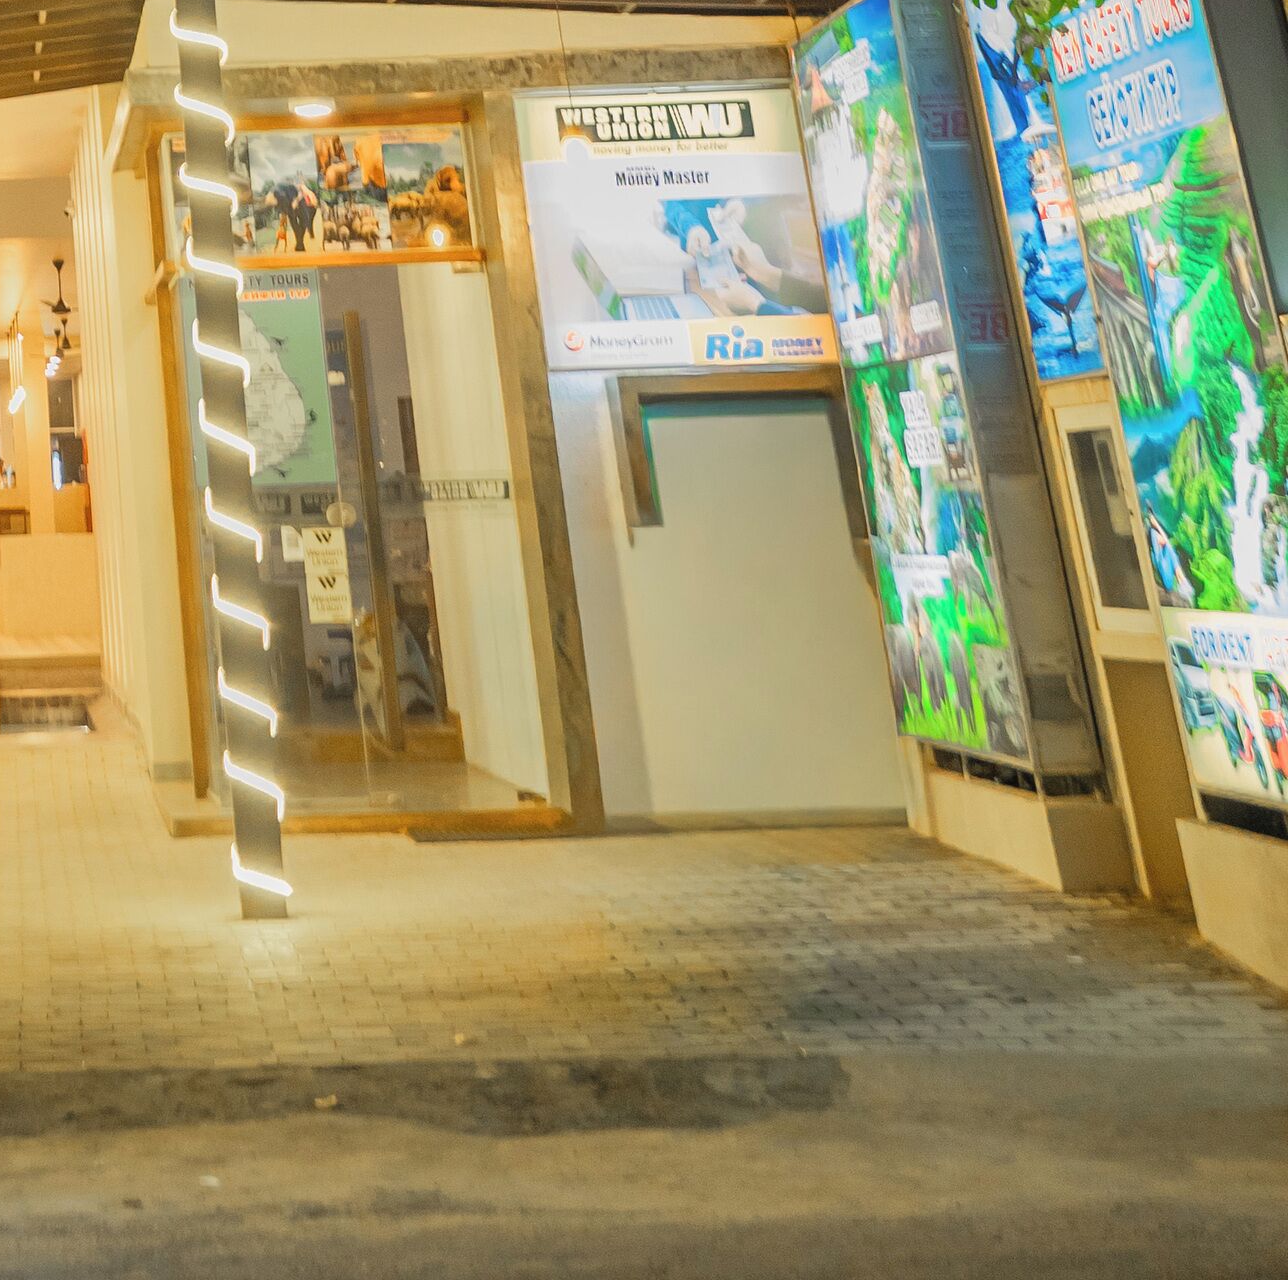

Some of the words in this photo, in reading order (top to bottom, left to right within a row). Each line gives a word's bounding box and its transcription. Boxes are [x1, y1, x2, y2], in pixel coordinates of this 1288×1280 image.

[561, 104, 669, 127] WESTERN
[678, 102, 744, 138] WU
[596, 121, 672, 141] UNION
[615, 170, 660, 188] Money
[663, 170, 710, 185] Master
[270, 273, 309, 287] TOURS
[589, 334, 674, 349] MoneyGram
[706, 325, 764, 360] Ria
[1191, 625, 1218, 659] FOR
[1220, 629, 1255, 662] RENT
